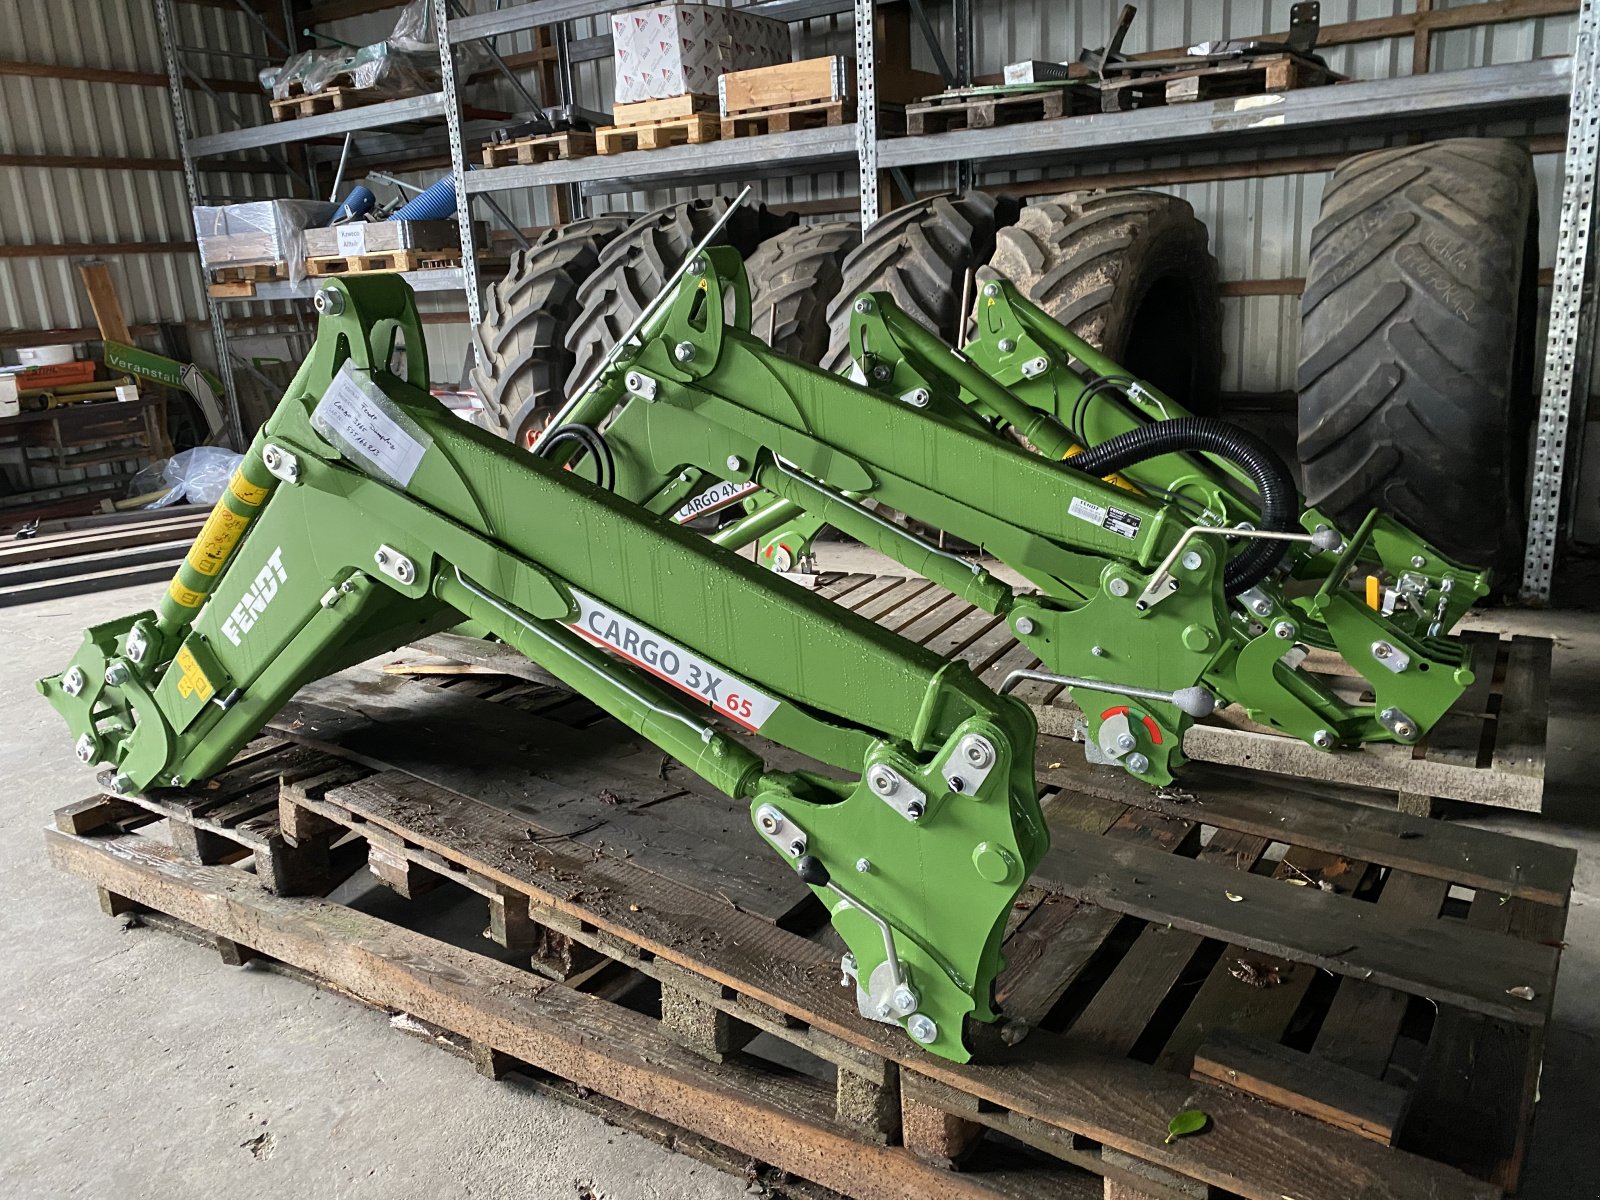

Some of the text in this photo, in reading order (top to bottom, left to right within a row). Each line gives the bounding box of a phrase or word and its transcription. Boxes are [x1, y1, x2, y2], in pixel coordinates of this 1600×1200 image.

[109, 354, 182, 385] Veranstalt
[679, 490, 720, 517] CARGO
[722, 483, 739, 497] 4X
[220, 545, 288, 648] FENDT
[588, 610, 753, 718] CARGO 3X 65
